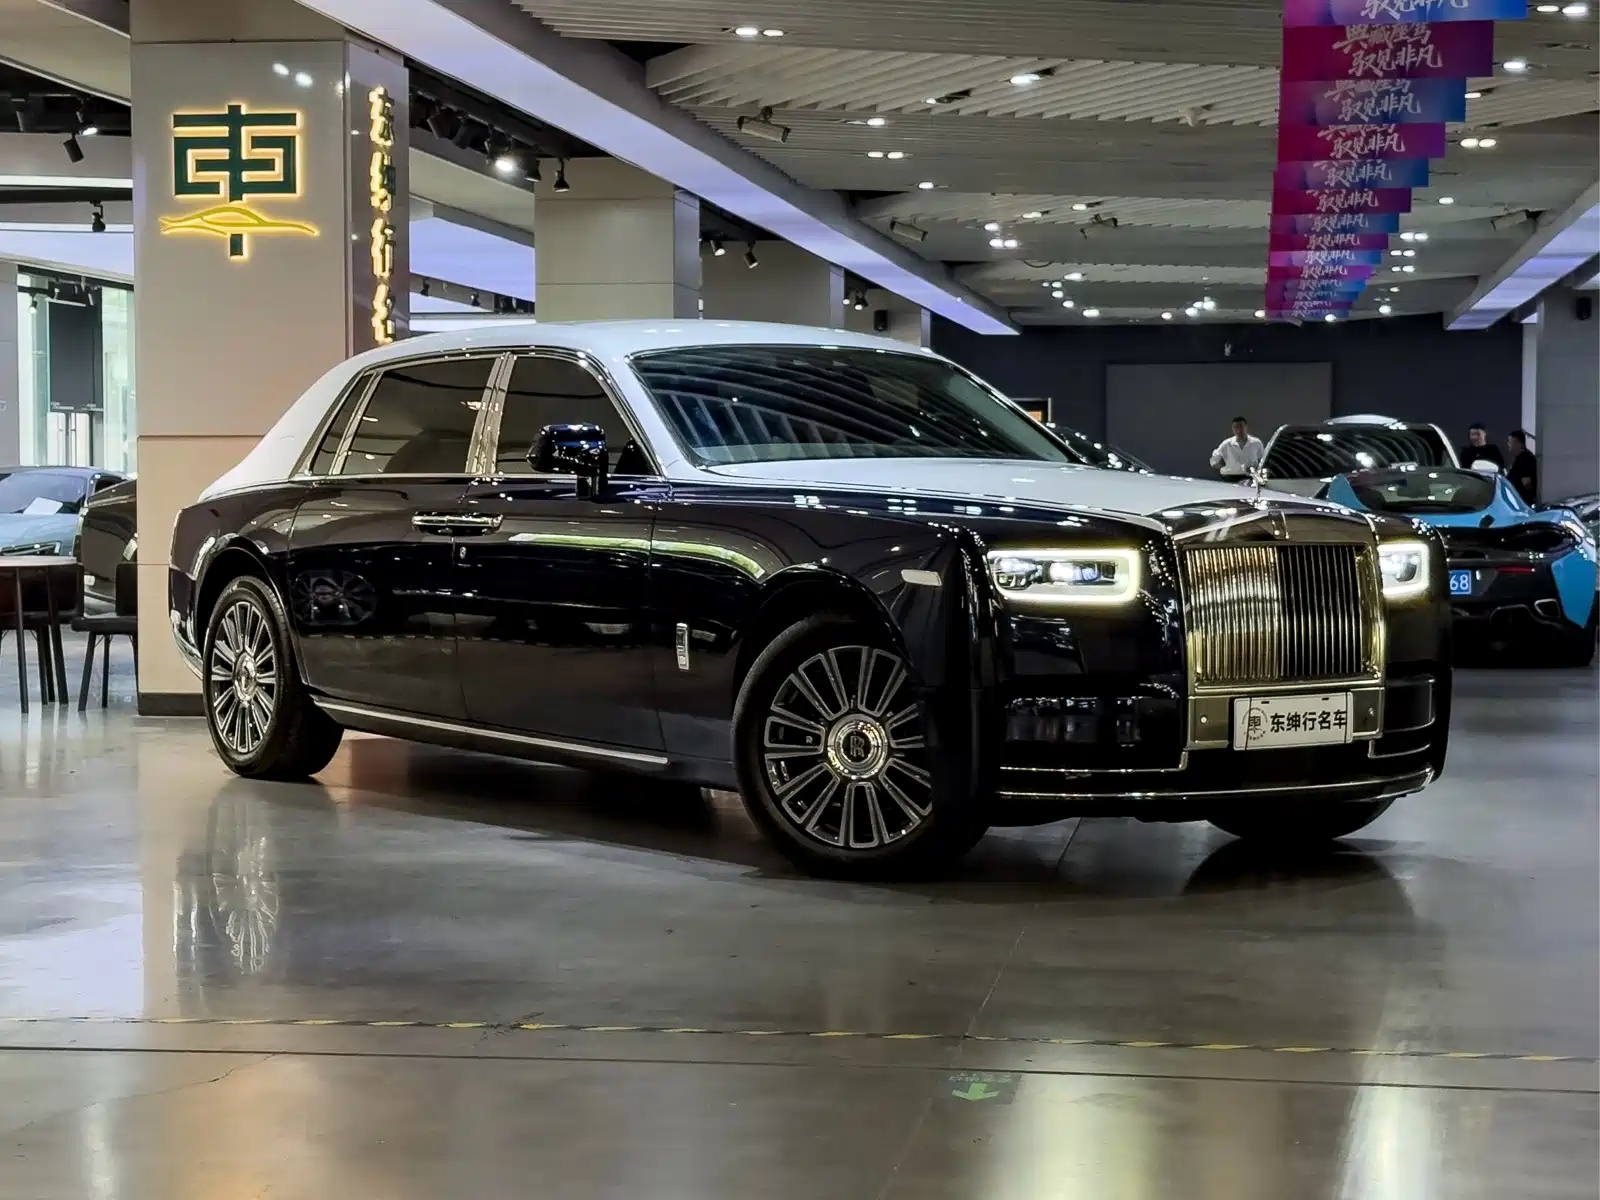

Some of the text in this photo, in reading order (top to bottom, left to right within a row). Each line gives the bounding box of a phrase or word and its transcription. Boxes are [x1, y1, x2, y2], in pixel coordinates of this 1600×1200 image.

[1450, 574, 1469, 591] 68
[1269, 709, 1347, 733] 东绅行名车
